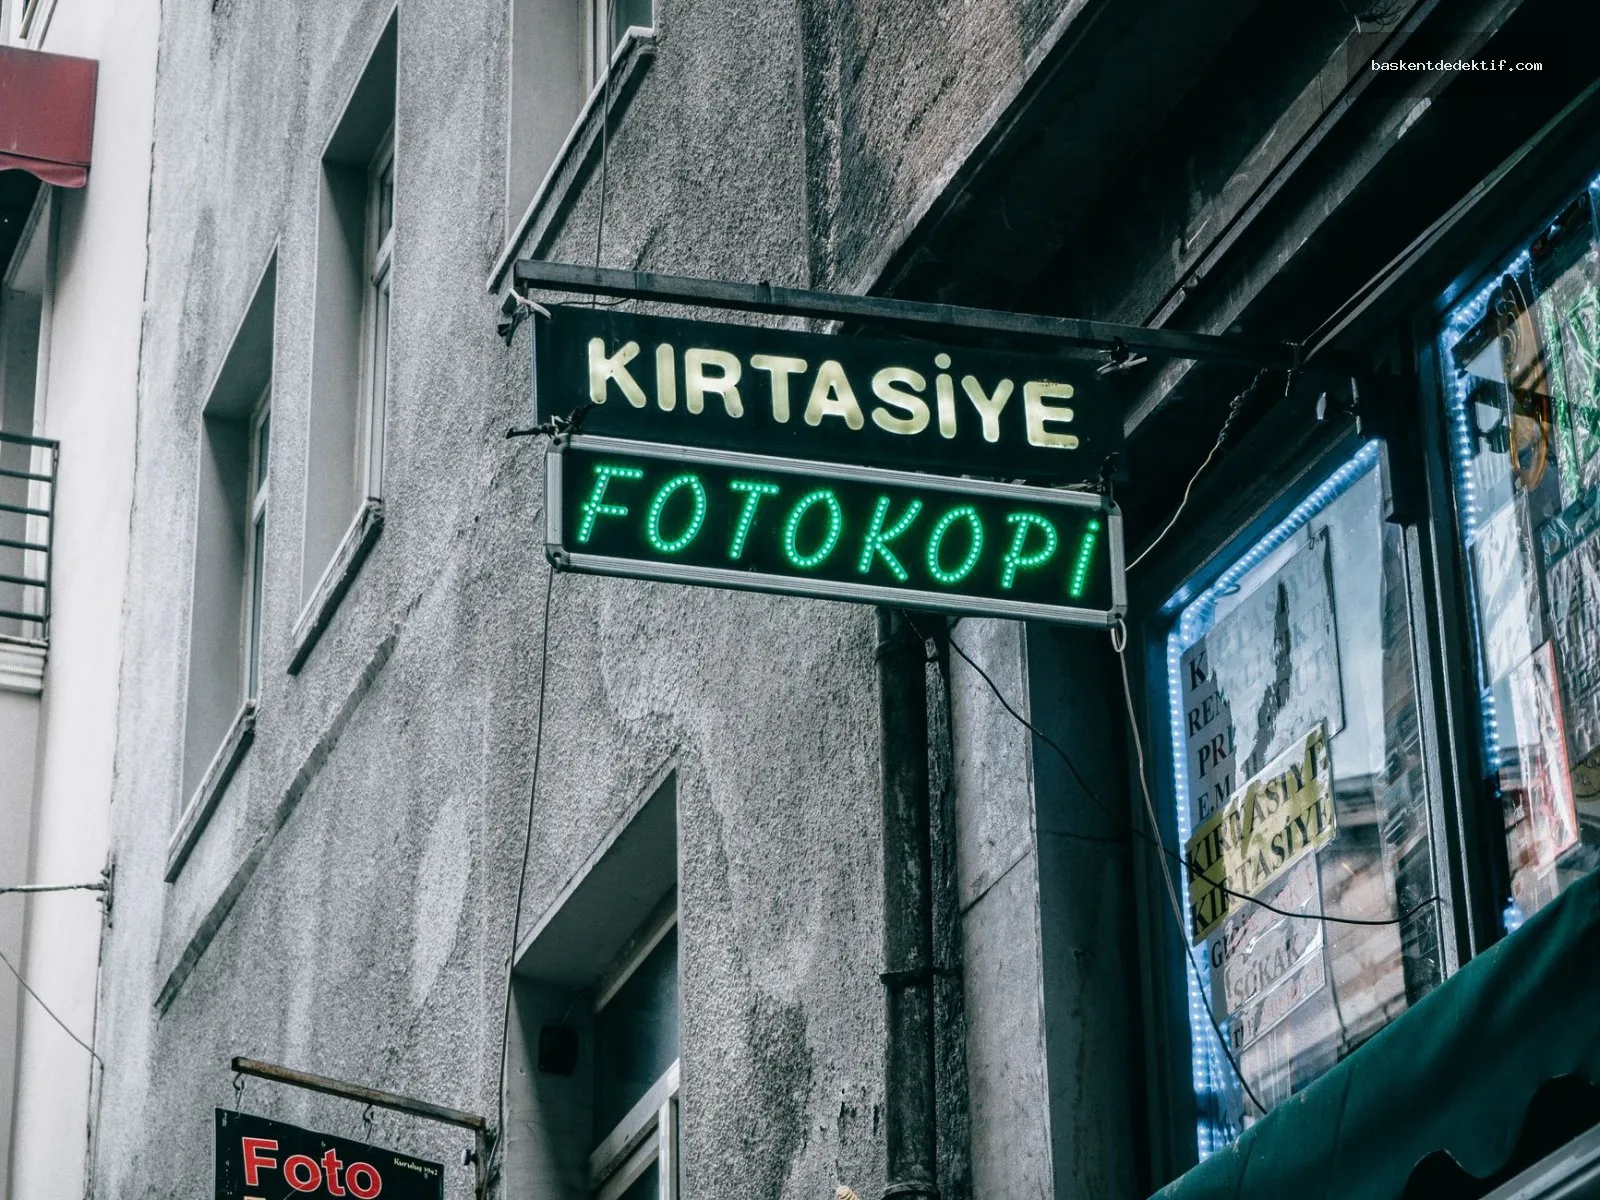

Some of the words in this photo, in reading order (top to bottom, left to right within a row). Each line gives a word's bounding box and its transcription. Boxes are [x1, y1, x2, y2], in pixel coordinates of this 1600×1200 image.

[588, 337, 1080, 450] KIRTASİYE
[577, 464, 1102, 597] FOTOKOPİ
[241, 1136, 382, 1199] Foto
